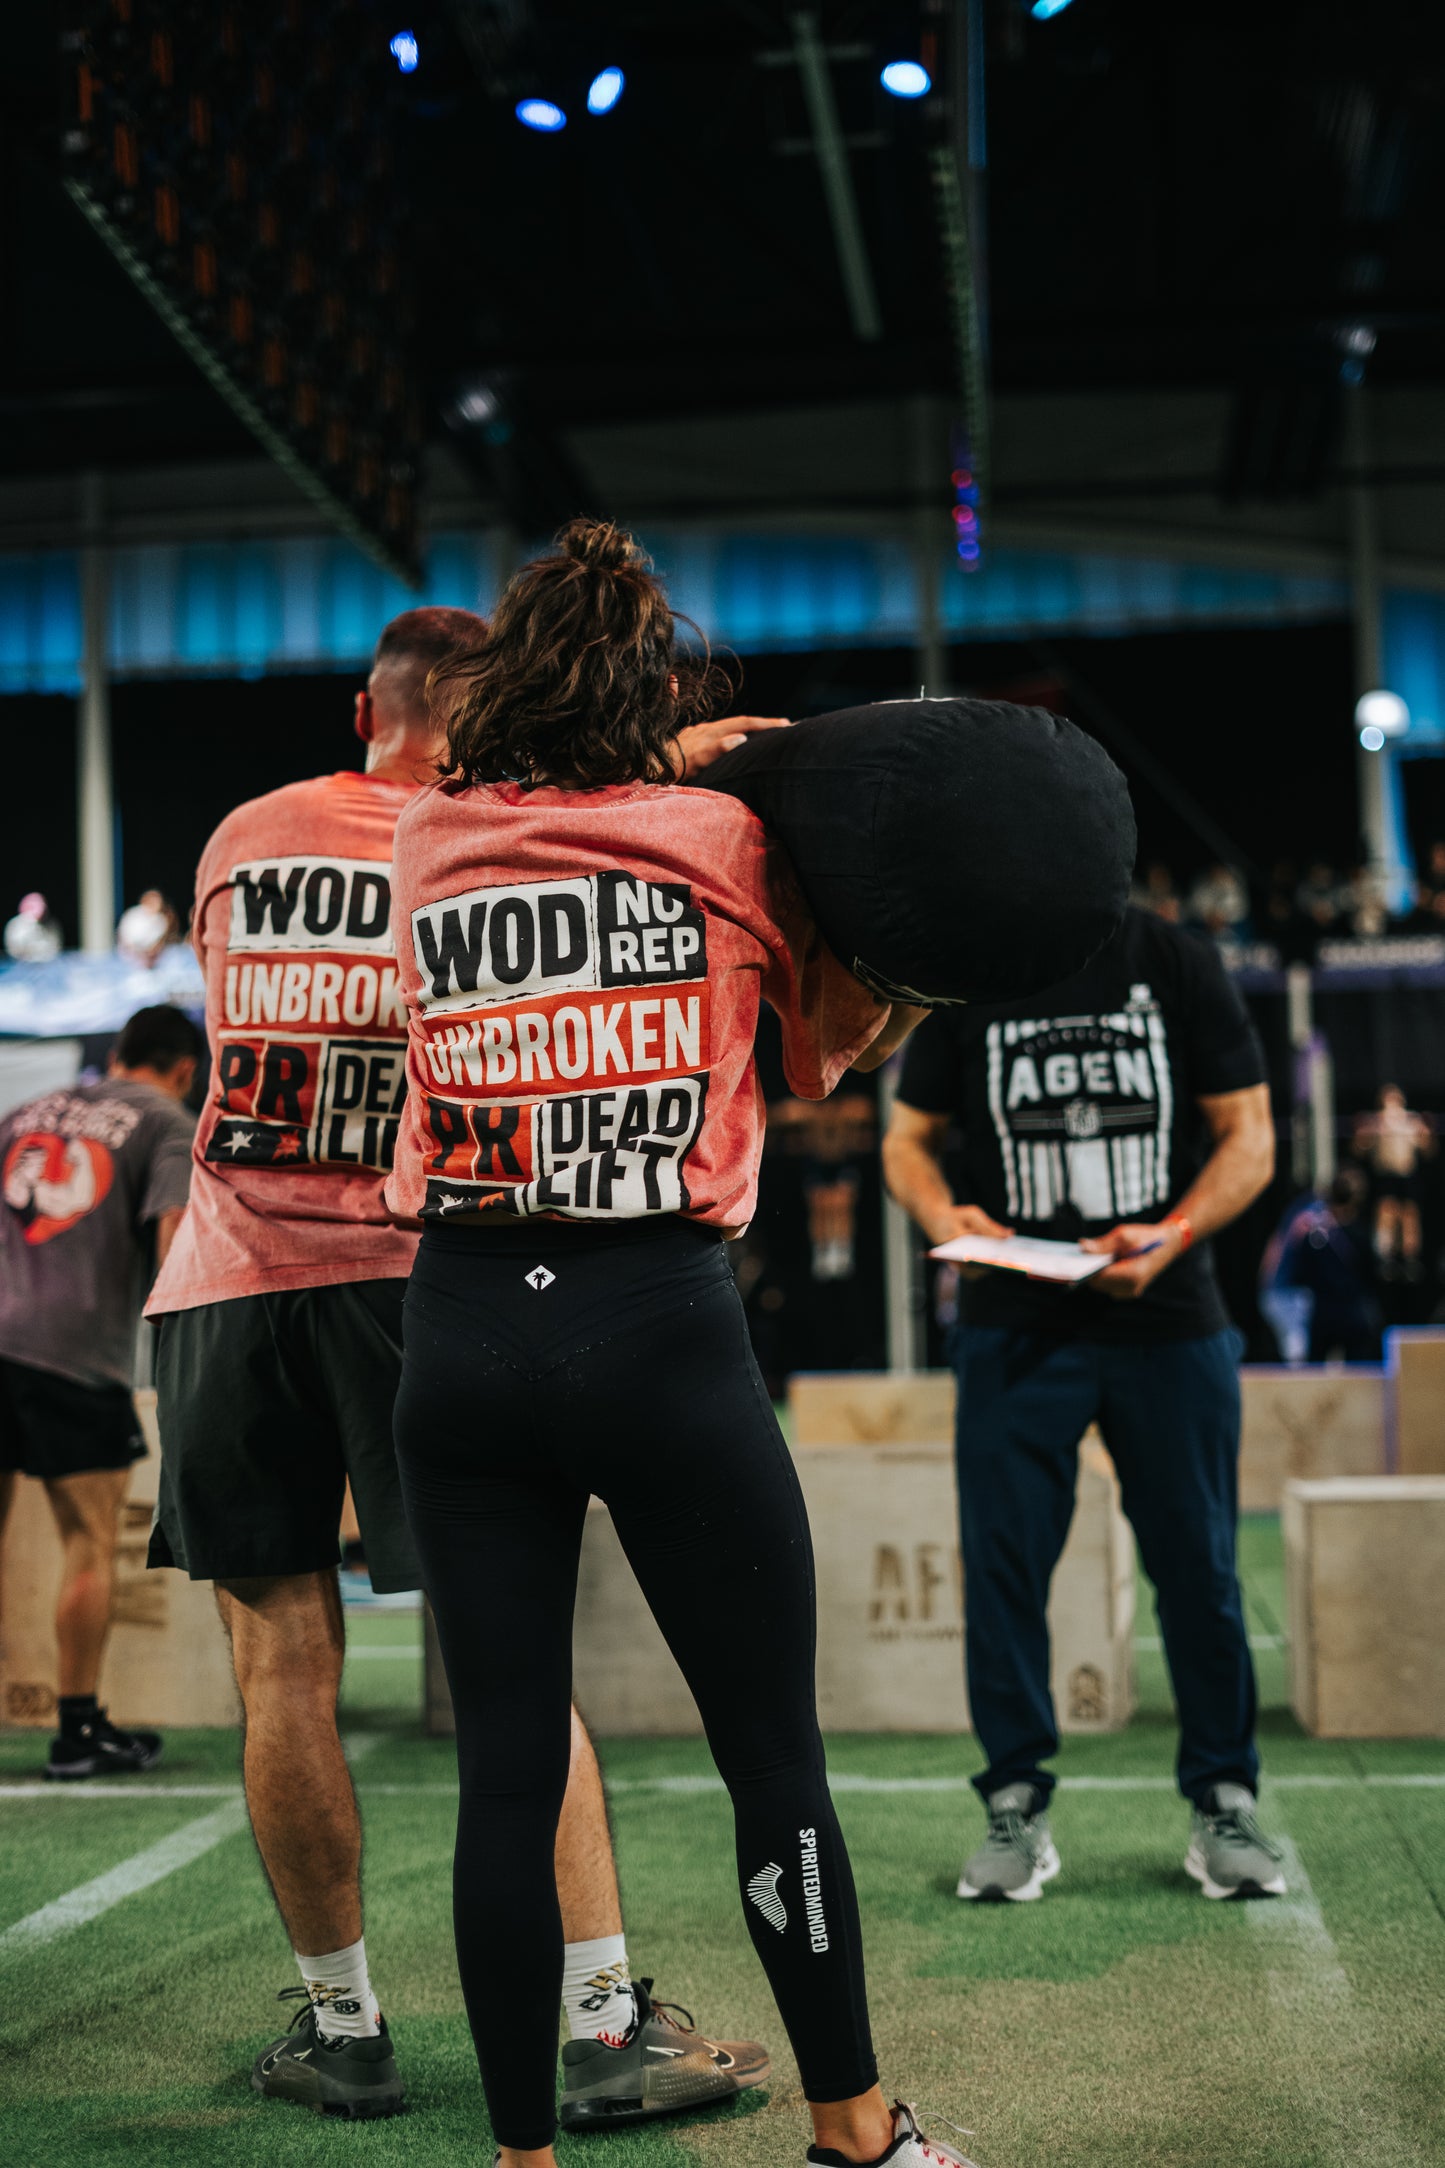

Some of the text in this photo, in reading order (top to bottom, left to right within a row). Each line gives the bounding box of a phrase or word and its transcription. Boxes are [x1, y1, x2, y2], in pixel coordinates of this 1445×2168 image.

[235, 866, 391, 939] WOD
[417, 893, 589, 999] WOD
[608, 926, 700, 974] REP
[425, 996, 701, 1087] UNBROKEN
[220, 1044, 308, 1123] PR
[548, 1087, 693, 1154] DEAD
[427, 1096, 525, 1177] PR
[536, 1139, 679, 1211] LIFT
[799, 1827, 830, 1953] SPIRITEDMINDED
